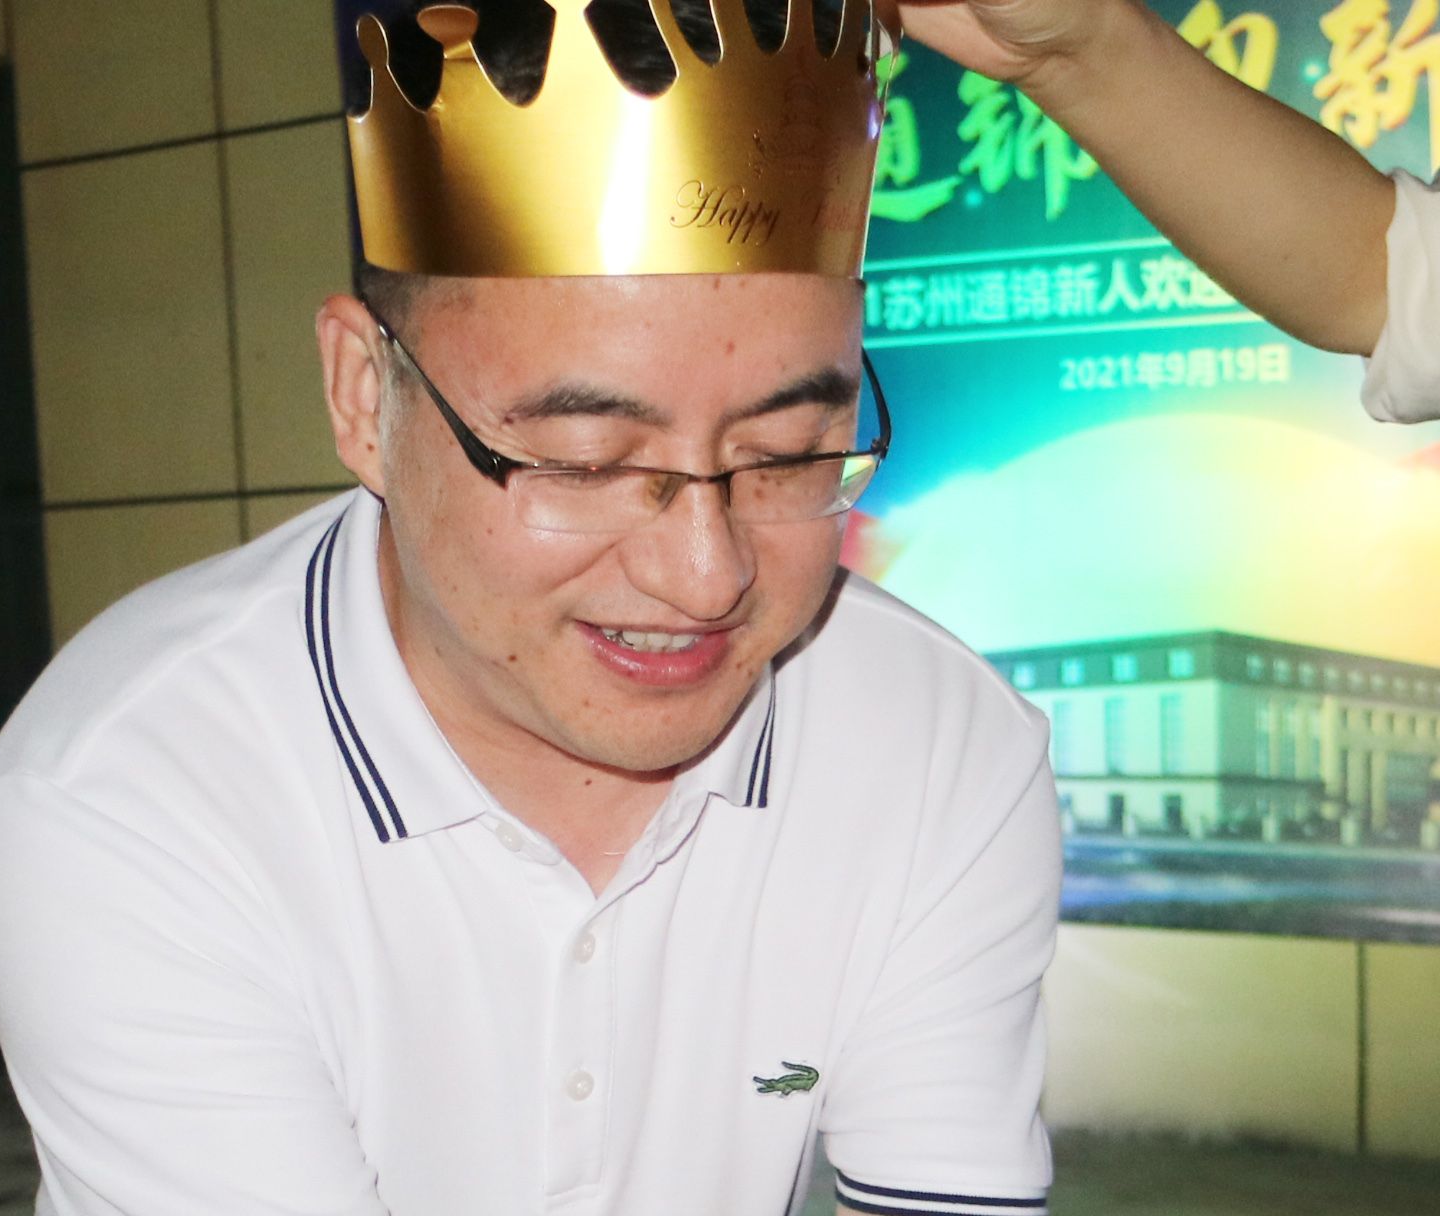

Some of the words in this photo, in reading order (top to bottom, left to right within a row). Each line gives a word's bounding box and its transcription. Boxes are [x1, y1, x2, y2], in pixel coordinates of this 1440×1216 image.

[669, 180, 781, 244] Happy
[1059, 343, 1291, 391] 2021年9月19日
